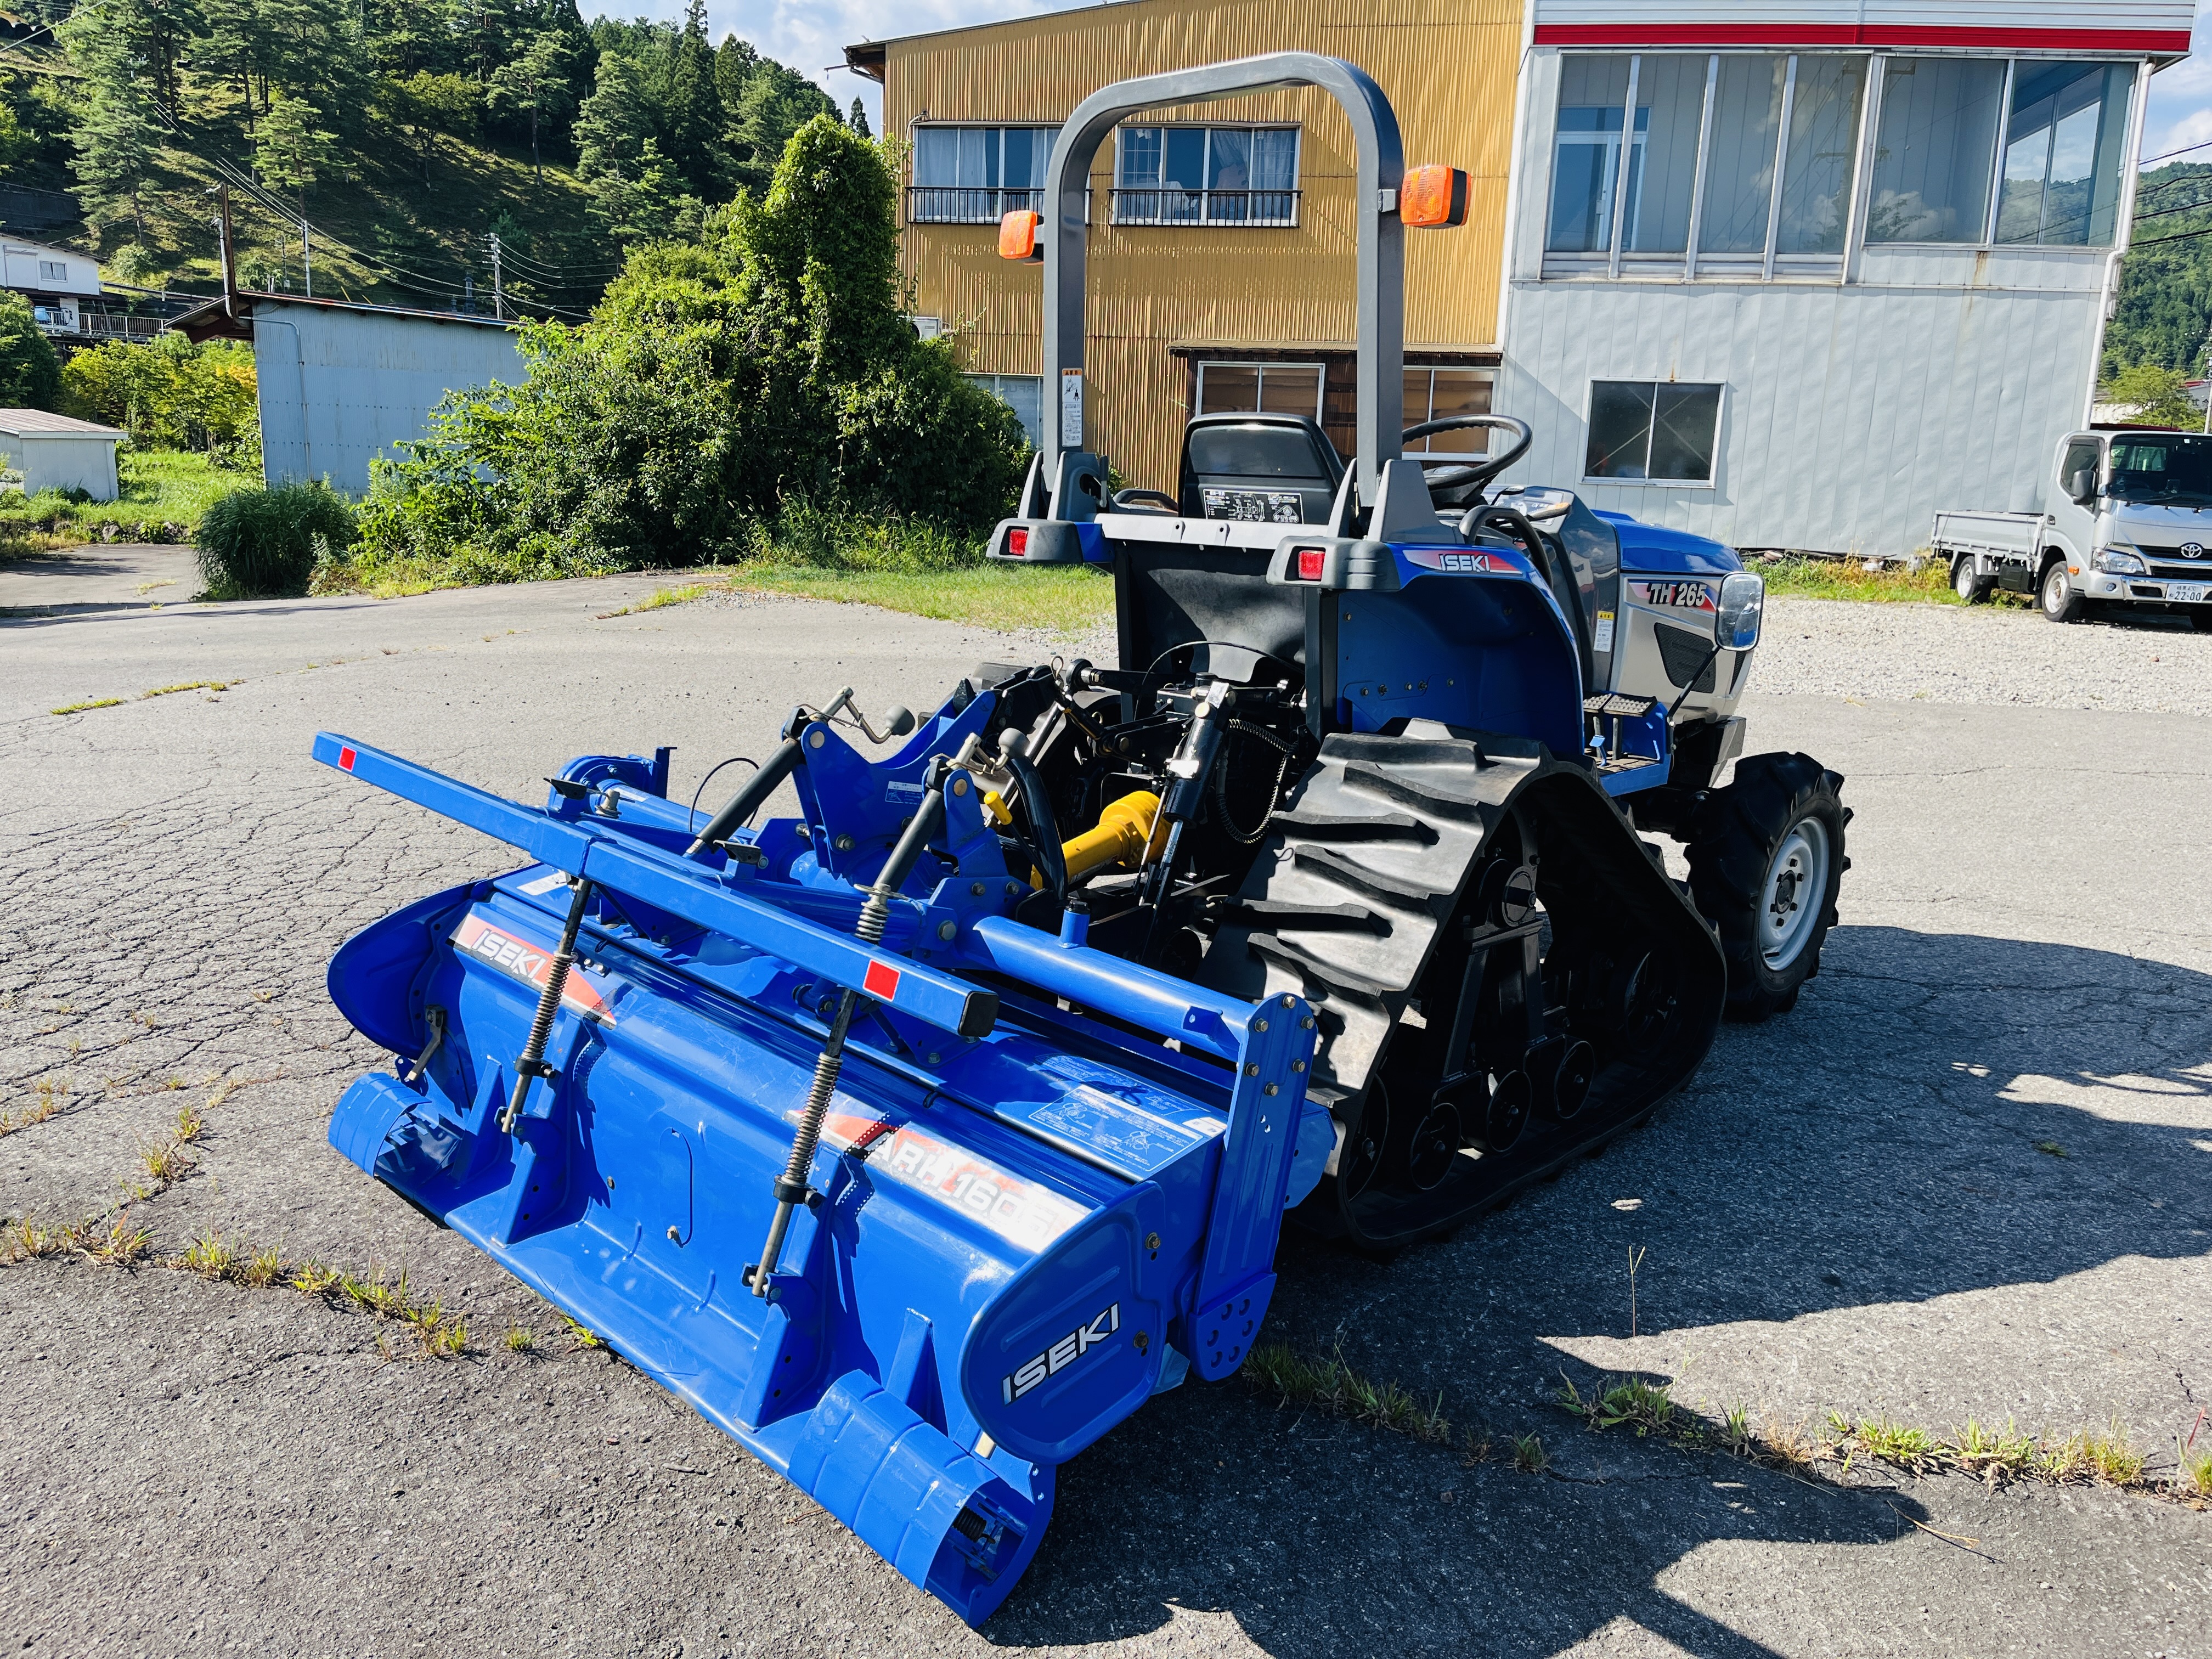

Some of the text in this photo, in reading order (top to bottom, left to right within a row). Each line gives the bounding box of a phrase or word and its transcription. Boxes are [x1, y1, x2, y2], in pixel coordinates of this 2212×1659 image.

[1439, 554, 1491, 572] ISEKI
[1647, 582, 1707, 607] TH 265
[471, 929, 547, 978] ISEKI
[1002, 1303, 1120, 1404] ISEKI
